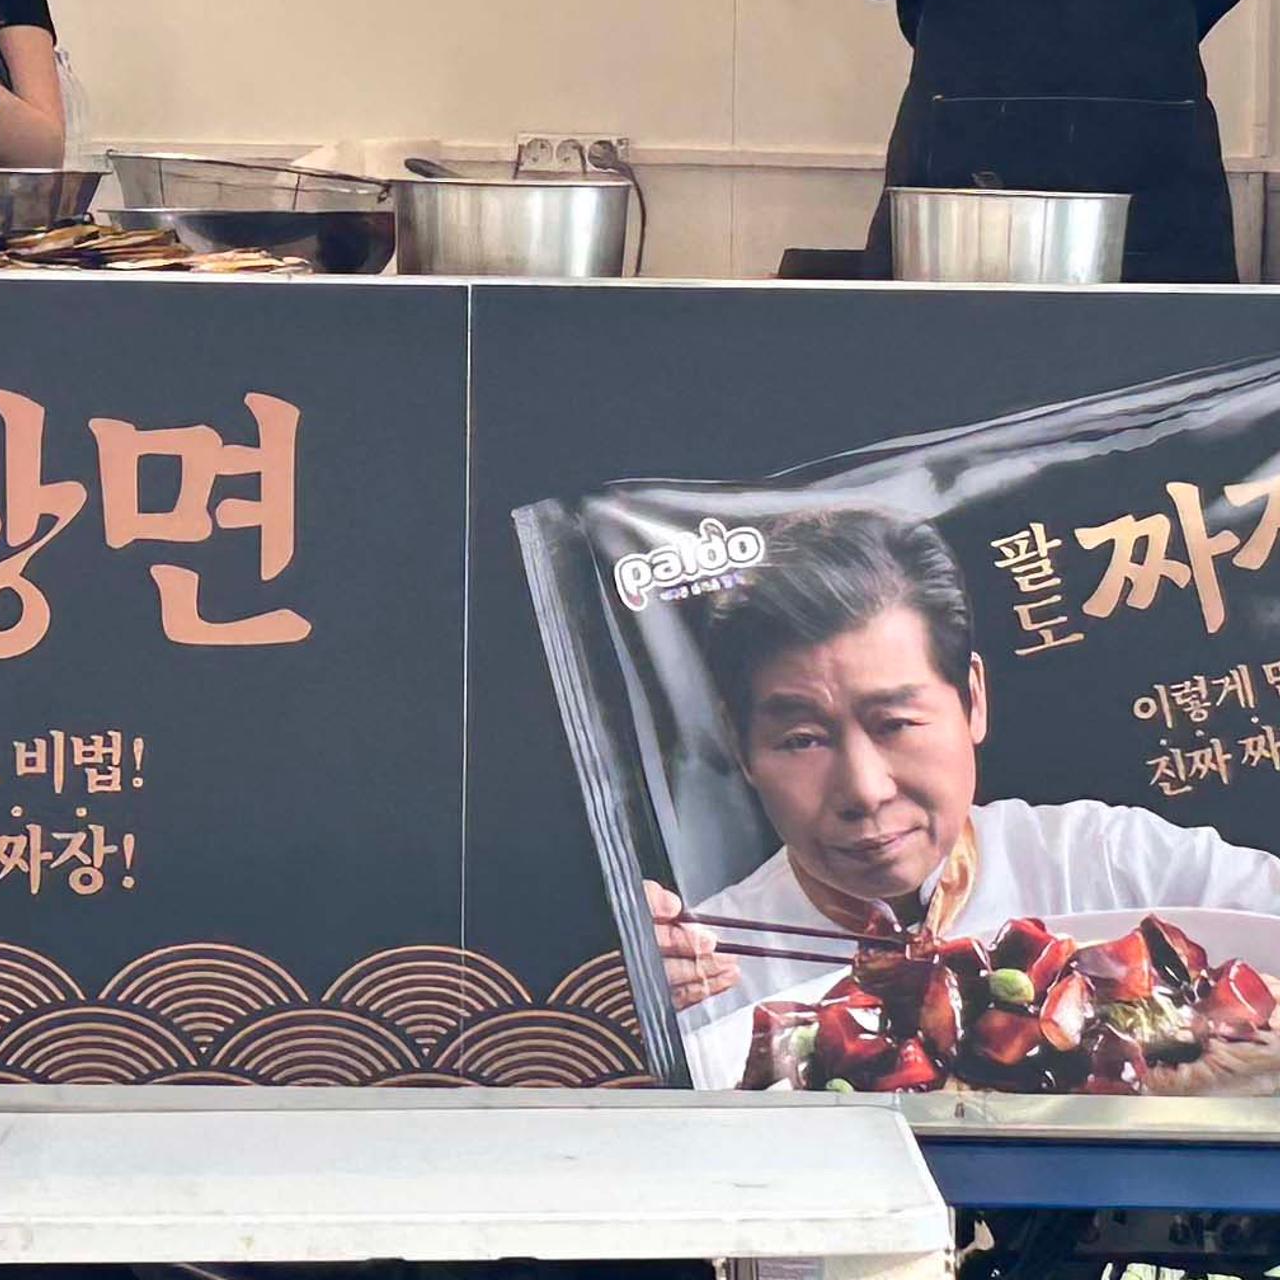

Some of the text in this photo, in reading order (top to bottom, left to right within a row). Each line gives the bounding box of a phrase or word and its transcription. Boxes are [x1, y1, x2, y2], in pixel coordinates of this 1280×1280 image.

[614, 518, 765, 612] paldo
[990, 522, 1085, 655] 팔도
[1132, 663, 1257, 730] 이렇게
[13, 729, 145, 794] 비법!
[1145, 736, 1232, 797] 진짜
